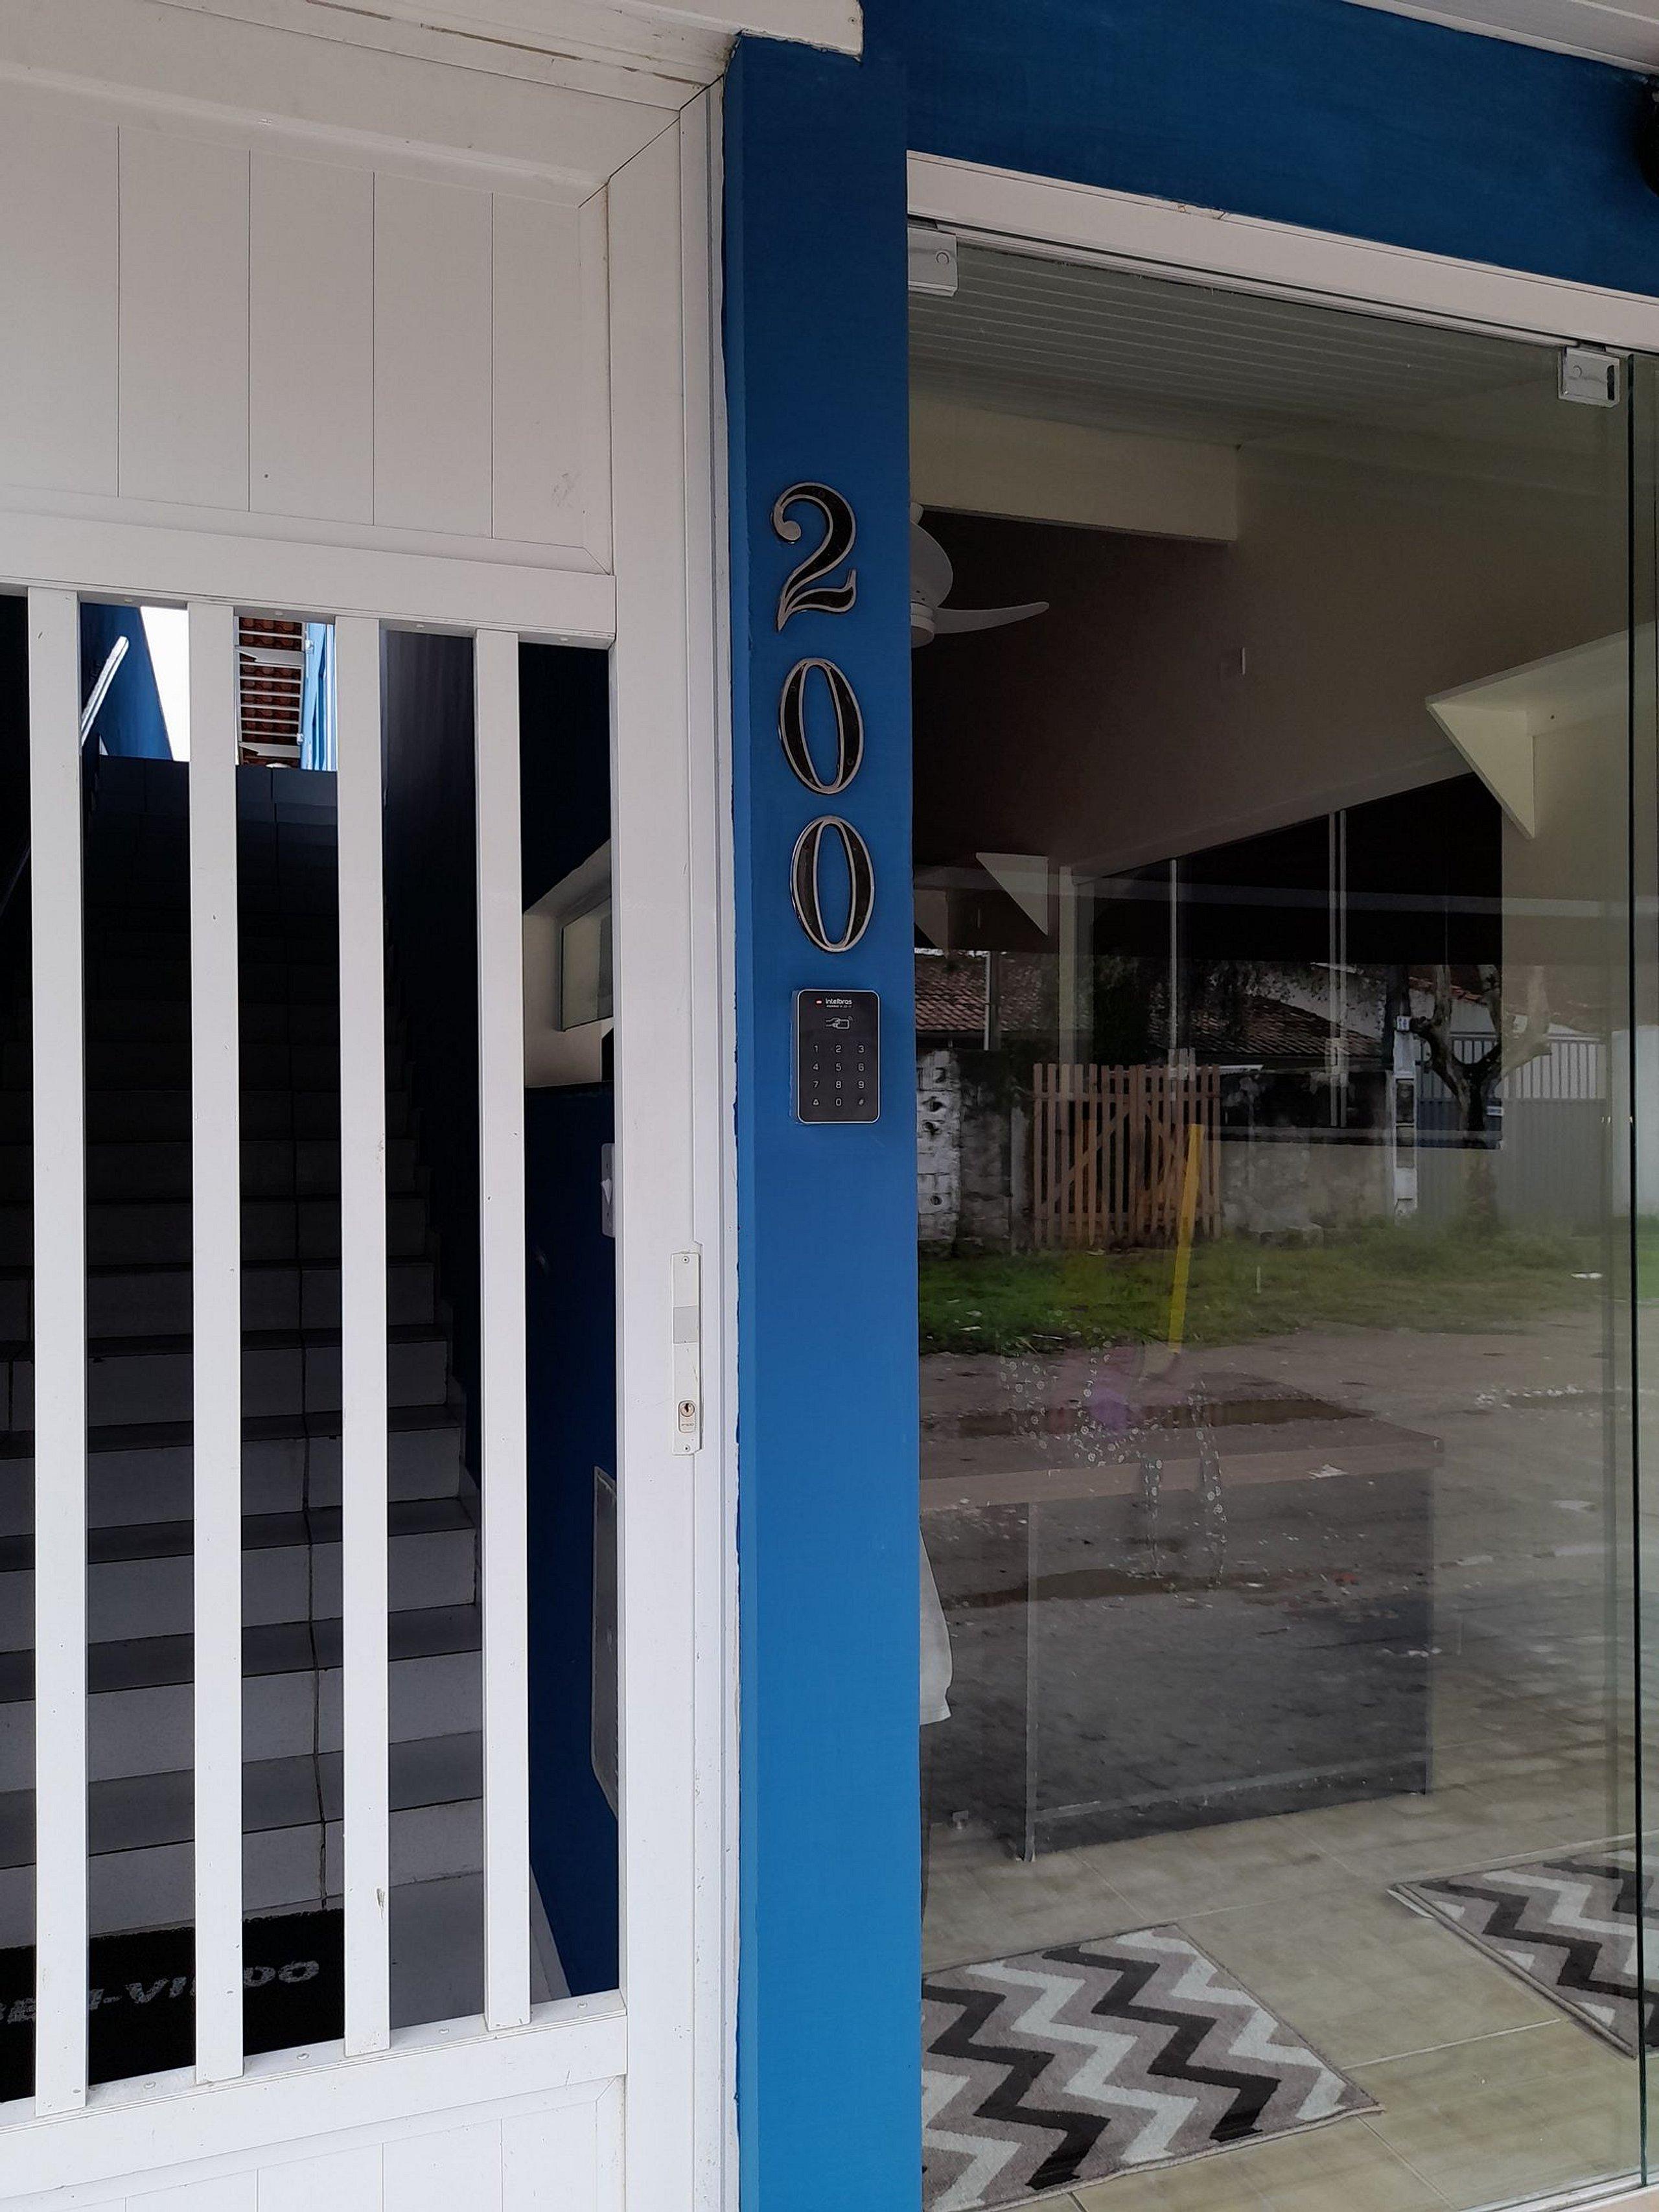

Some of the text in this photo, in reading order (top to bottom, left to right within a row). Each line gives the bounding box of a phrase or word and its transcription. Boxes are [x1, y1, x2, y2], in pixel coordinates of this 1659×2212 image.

[771, 482, 876, 954] 200
[835, 1045, 842, 1053] 2
[858, 1045, 864, 1053] 3
[835, 1063, 842, 1071] 5
[858, 1063, 864, 1071] 6
[835, 1080, 842, 1089] 8
[858, 1080, 864, 1089] 9
[835, 1098, 842, 1106] 0
